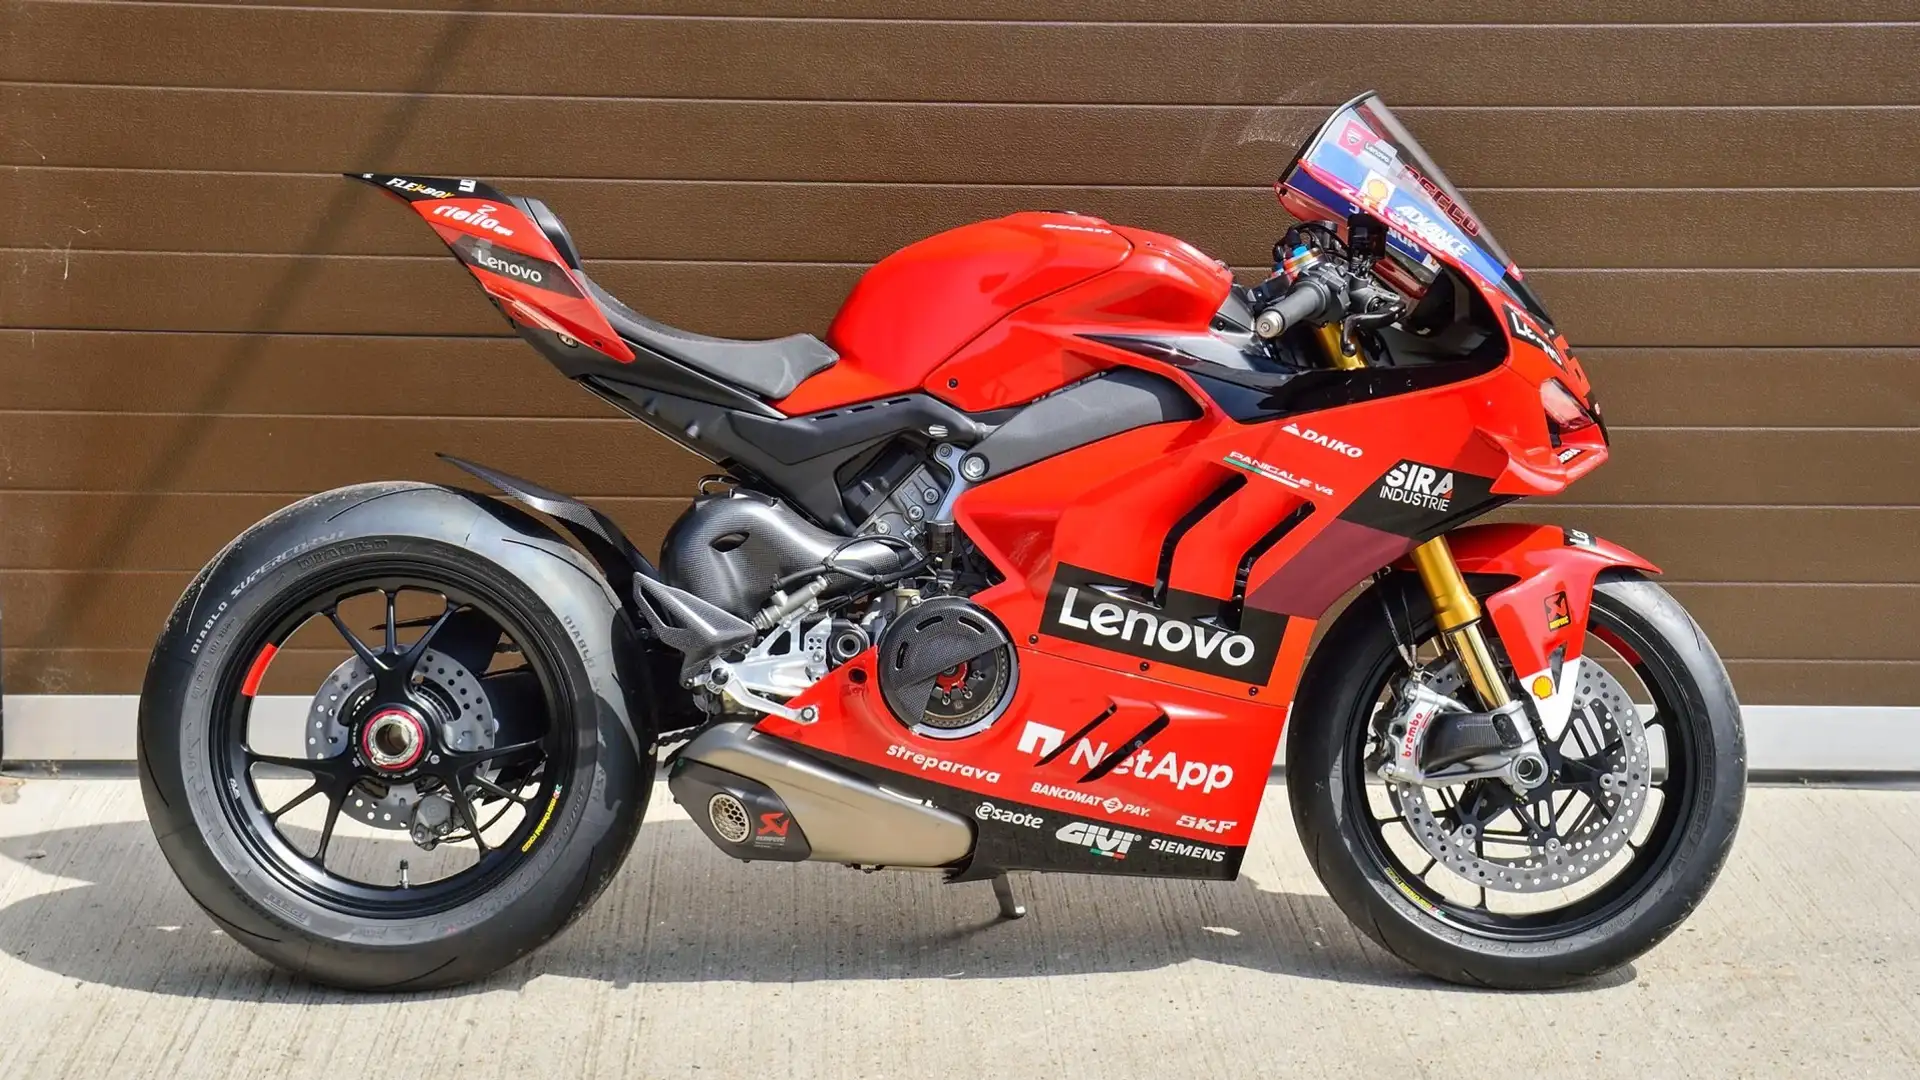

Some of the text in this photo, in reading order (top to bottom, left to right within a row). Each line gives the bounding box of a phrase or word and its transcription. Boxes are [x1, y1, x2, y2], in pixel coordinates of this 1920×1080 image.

[1396, 206, 1472, 257] ADVANCE
[478, 249, 542, 282] Lenovo
[1299, 428, 1363, 458] DAIKO
[1229, 451, 1334, 496] PANIGALE V4
[1385, 462, 1455, 499] SIRA
[1379, 485, 1450, 512] INDUSTRIE
[190, 600, 228, 655] DIABLO
[1058, 587, 1255, 667] Lenovo
[1401, 713, 1423, 757] brembo
[886, 744, 1001, 783] streparava
[1030, 782, 1103, 807] BANCOMAT
[1175, 814, 1238, 834] SKF
[1149, 838, 1226, 862] SIEMENS
